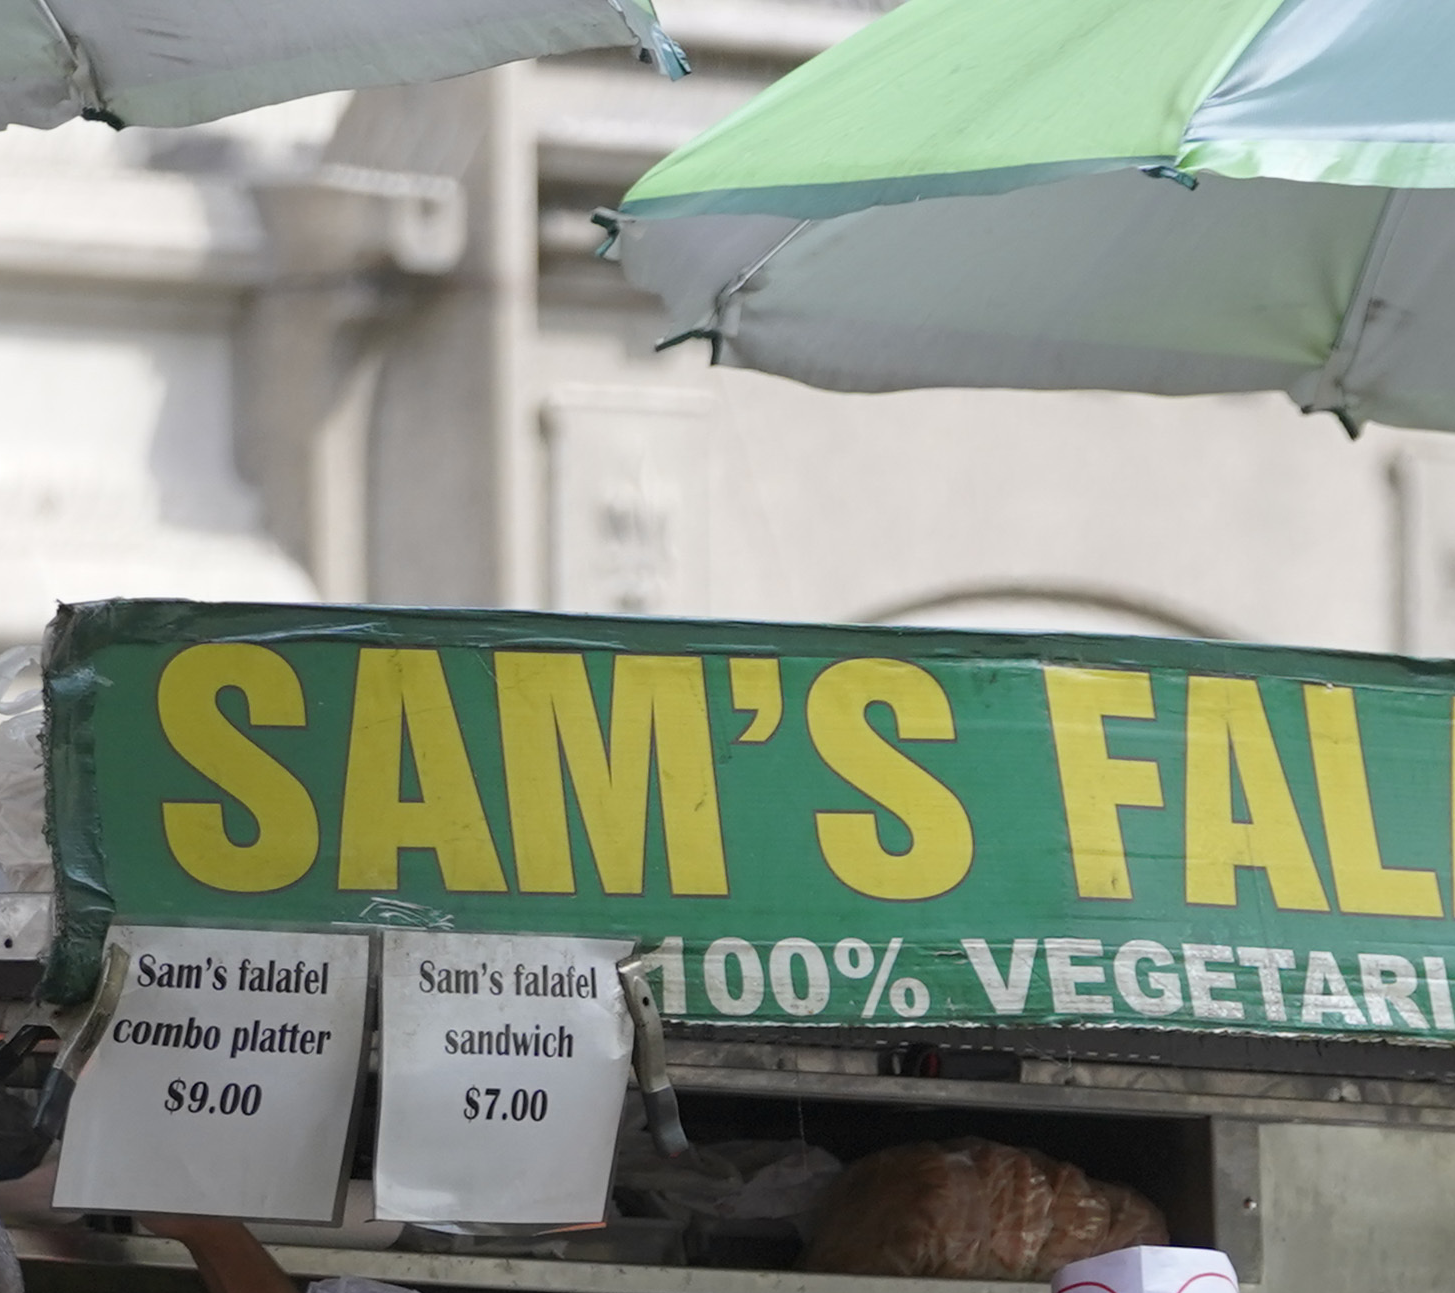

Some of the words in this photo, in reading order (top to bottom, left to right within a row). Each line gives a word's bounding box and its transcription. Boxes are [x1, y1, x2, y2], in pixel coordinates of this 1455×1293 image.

[155, 642, 976, 900] SAM'S
[137, 953, 227, 994] Sam's
[237, 957, 330, 996] falafel
[419, 959, 505, 996] Sam's
[514, 963, 598, 1000] falafel
[641, 934, 931, 1022] 100%
[112, 1018, 221, 1052] combo
[229, 1022, 333, 1059] platter
[444, 1023, 575, 1060] sandwich
[163, 1077, 263, 1118] $9.00
[462, 1085, 549, 1124] $7.00
